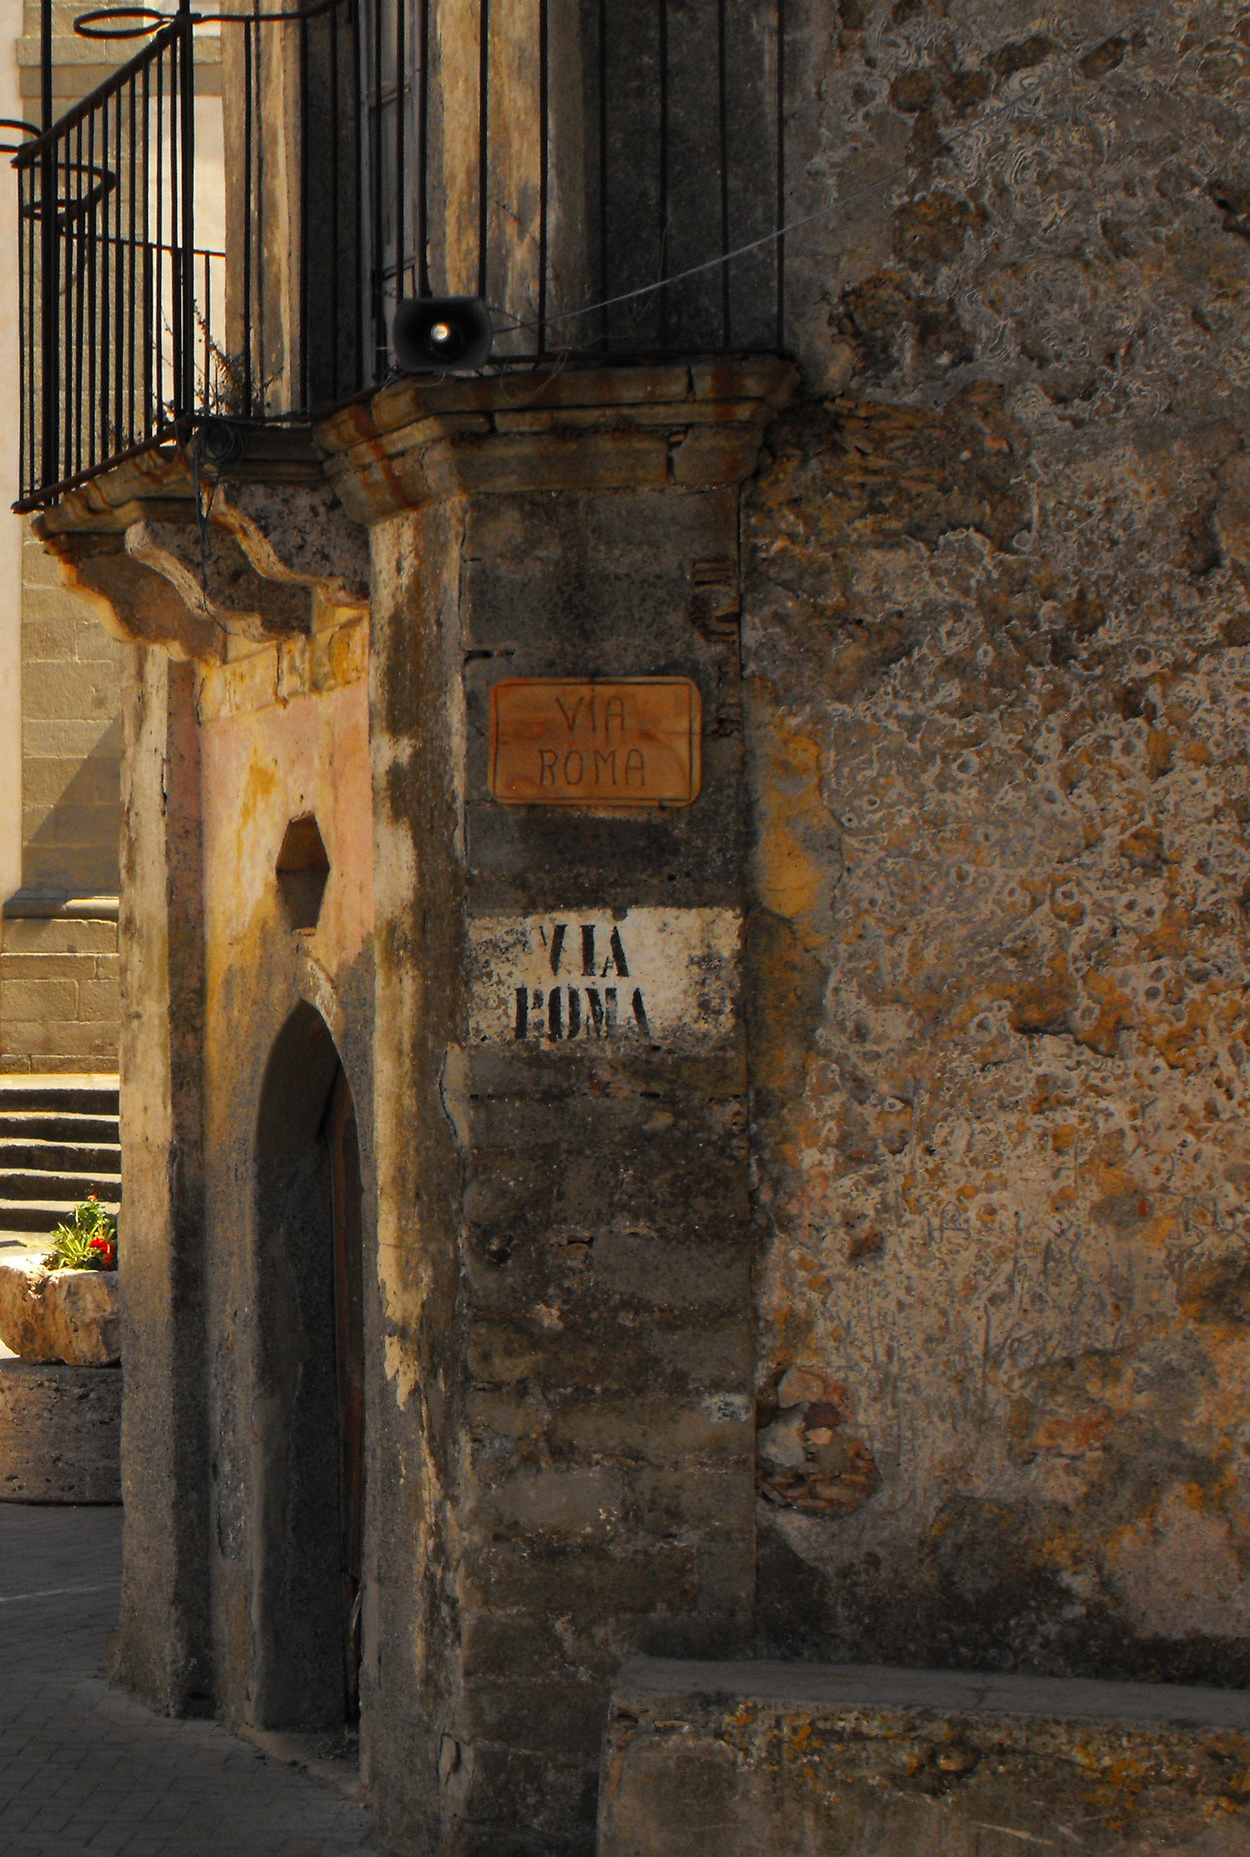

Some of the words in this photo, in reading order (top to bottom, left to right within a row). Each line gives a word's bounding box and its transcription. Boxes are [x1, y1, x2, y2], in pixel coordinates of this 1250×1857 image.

[557, 696, 626, 742] VIA
[539, 749, 645, 786] ROMA
[539, 925, 630, 978] VIA
